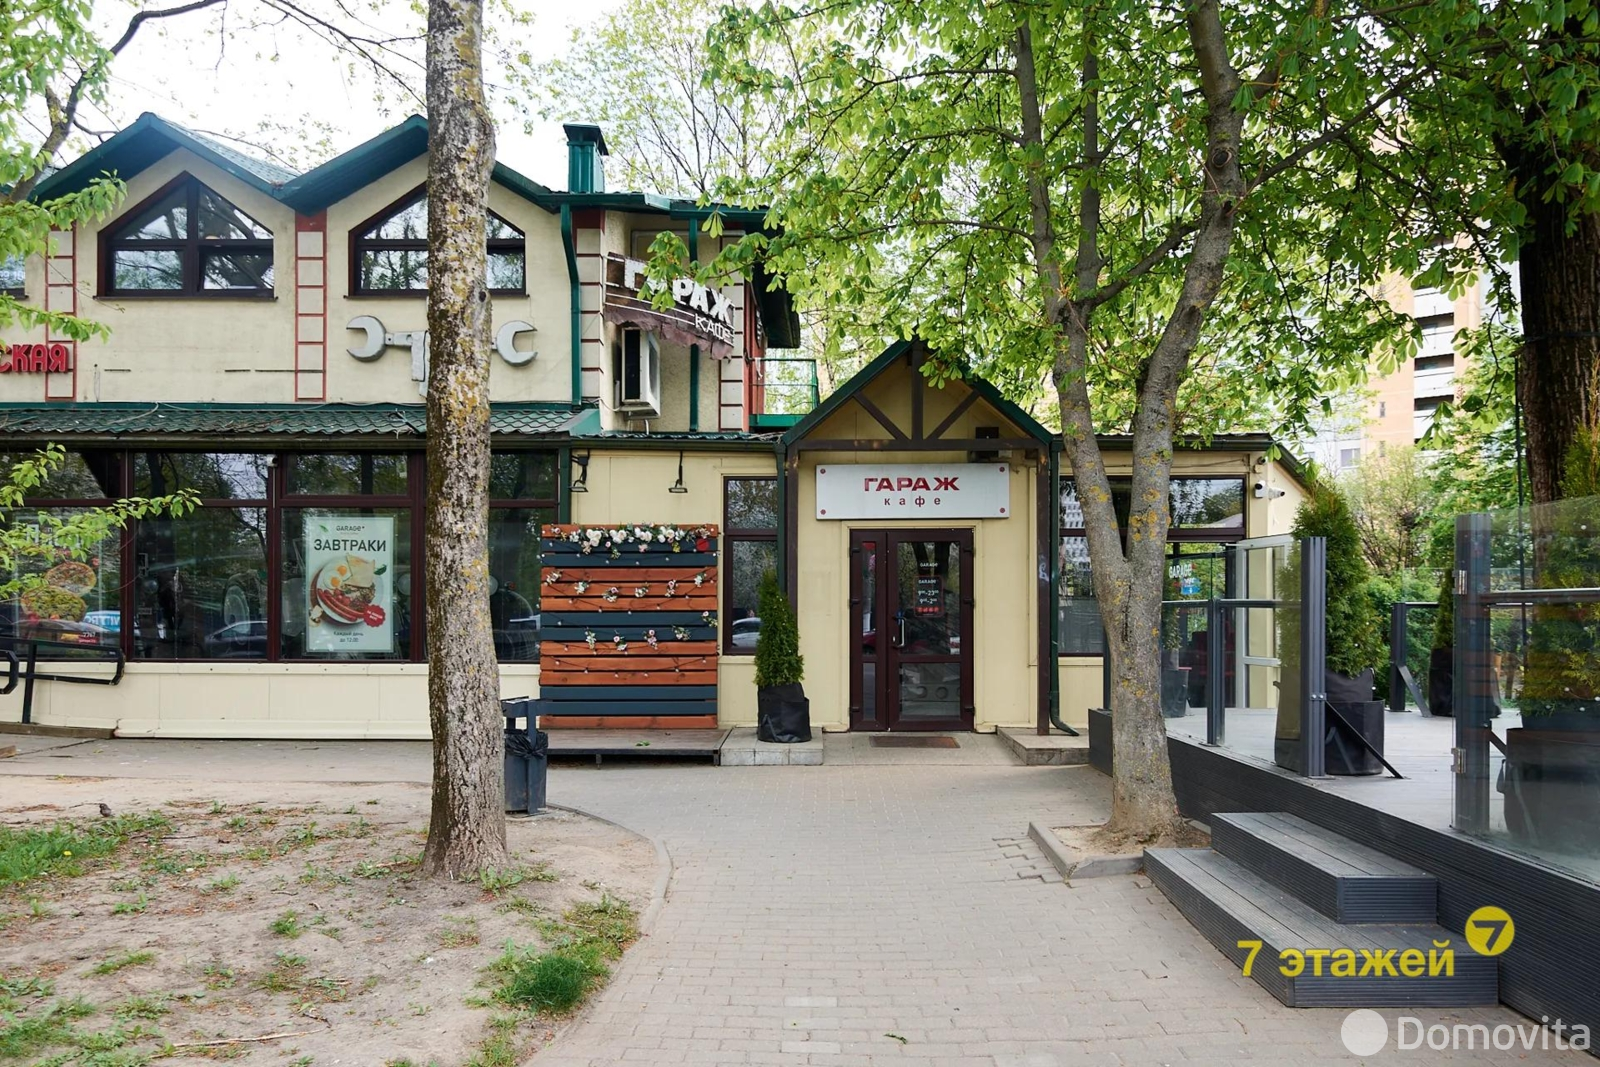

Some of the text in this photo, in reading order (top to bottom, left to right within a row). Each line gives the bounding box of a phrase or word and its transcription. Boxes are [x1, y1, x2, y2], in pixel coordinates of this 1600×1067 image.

[624, 259, 734, 328] ГРАЖ
[864, 477, 960, 492] ГАРАЖ
[883, 495, 941, 508] кафе
[313, 538, 387, 552] ЗАВТРАКИ
